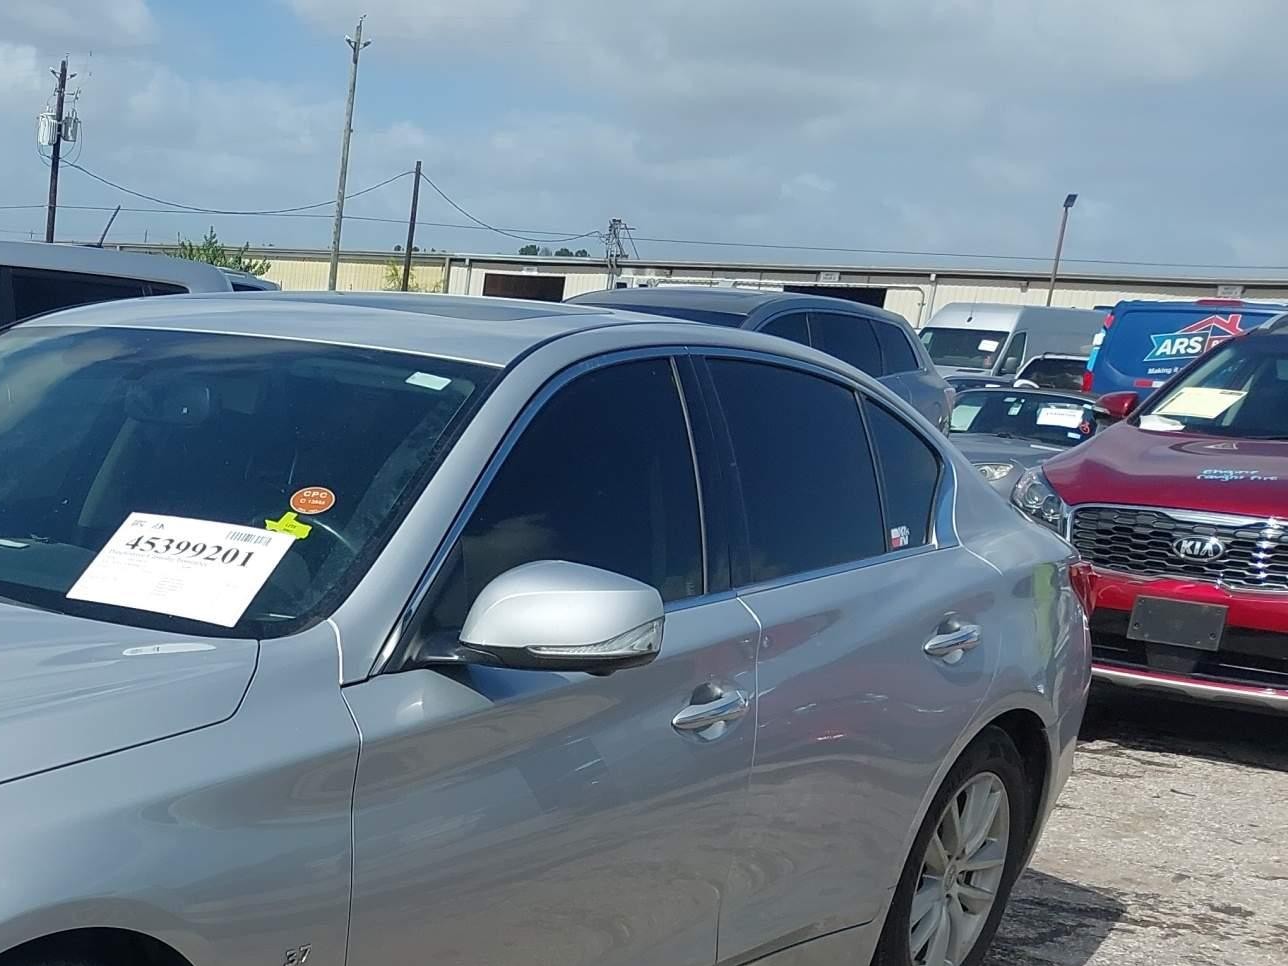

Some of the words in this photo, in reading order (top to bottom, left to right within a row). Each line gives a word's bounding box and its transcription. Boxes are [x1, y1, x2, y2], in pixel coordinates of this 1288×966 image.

[1155, 337, 1204, 356] ARS
[303, 490, 329, 499] CPC
[125, 535, 254, 567] 45399201
[1180, 540, 1214, 556] KIA
